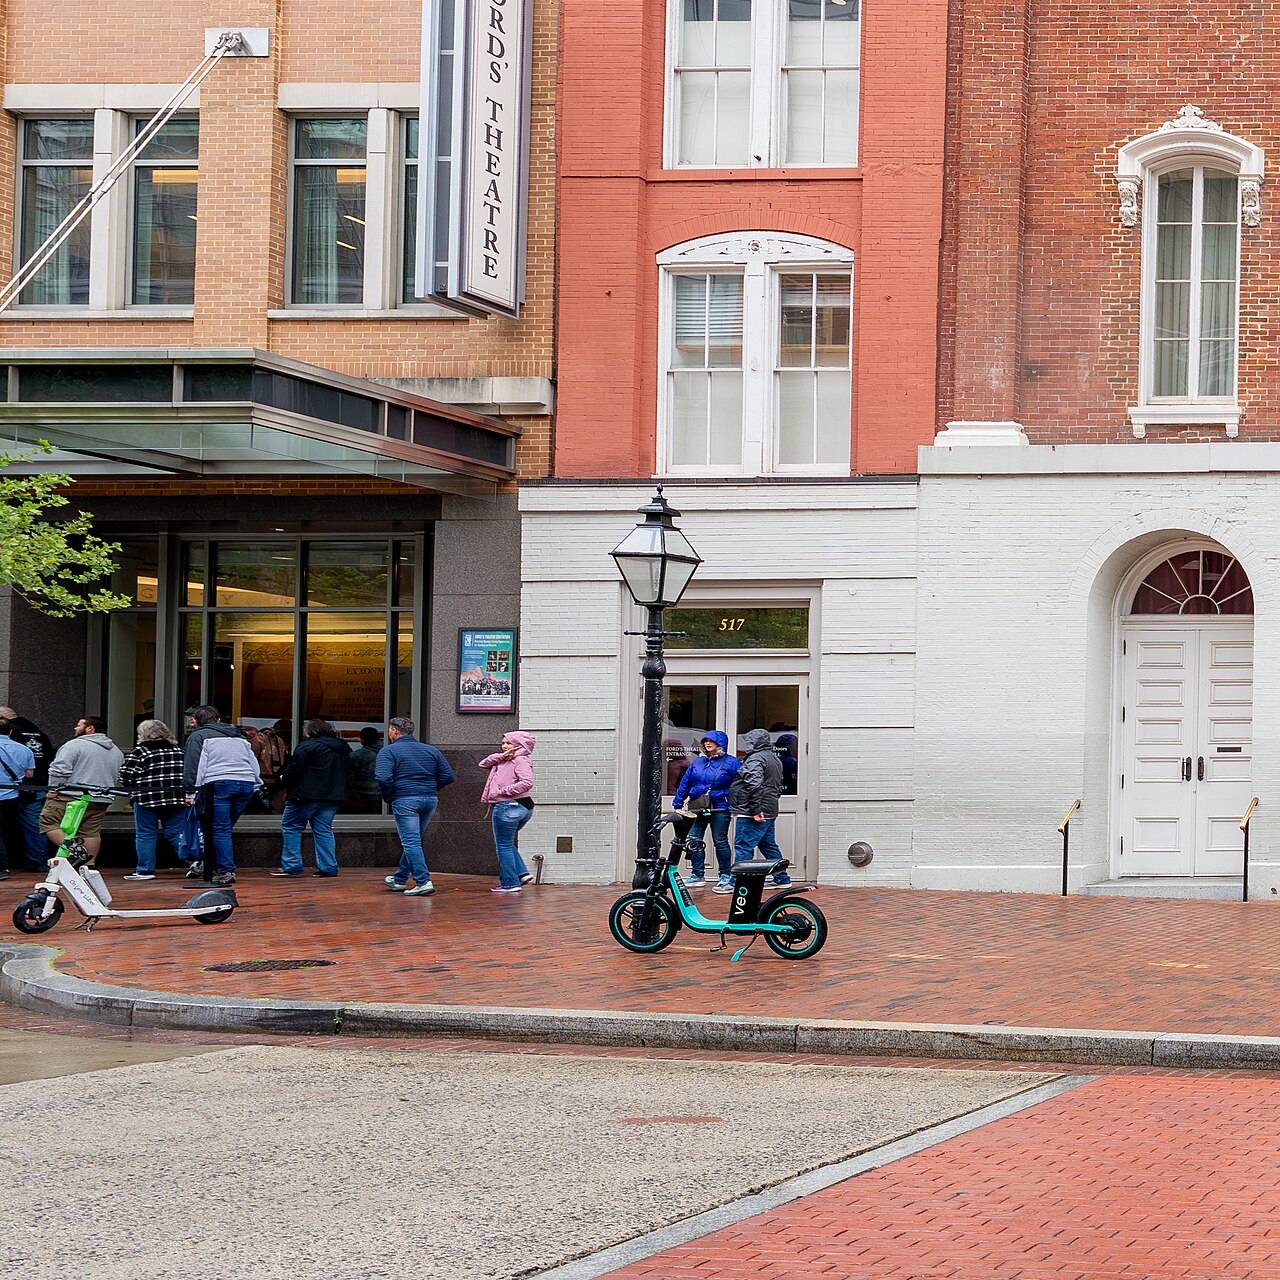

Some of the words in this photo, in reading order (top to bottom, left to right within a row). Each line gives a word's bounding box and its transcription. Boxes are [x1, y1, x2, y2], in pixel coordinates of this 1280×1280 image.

[481, 97, 504, 280] THEATRE
[718, 618, 746, 631] 517
[734, 885, 749, 915] veo
